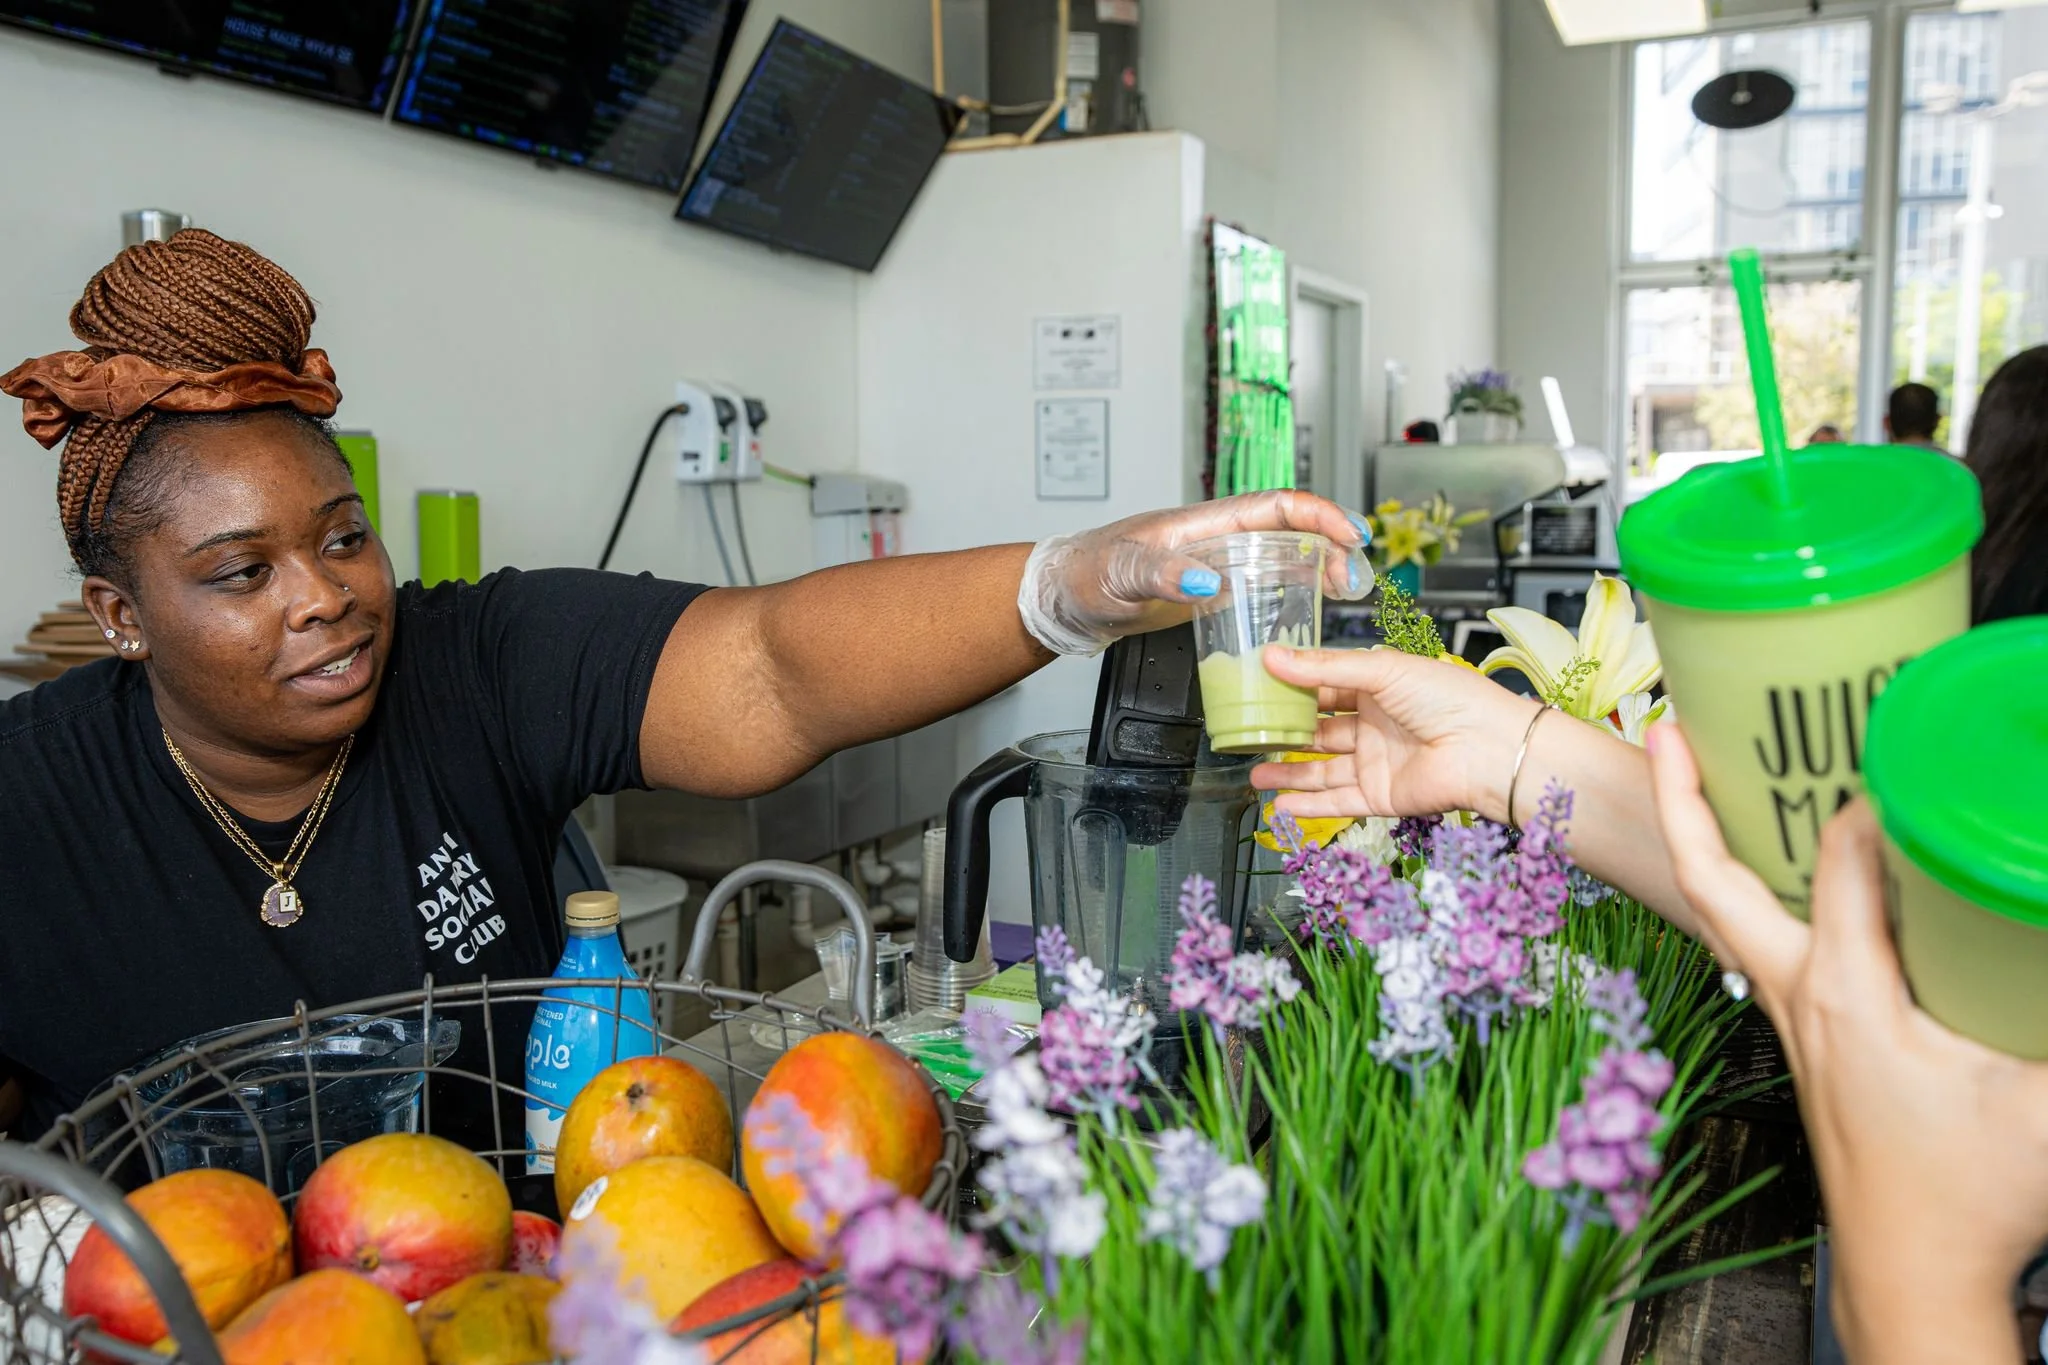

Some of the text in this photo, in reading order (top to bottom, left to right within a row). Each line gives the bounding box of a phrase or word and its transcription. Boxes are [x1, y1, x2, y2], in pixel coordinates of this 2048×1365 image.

[1754, 657, 1905, 778] JUI
[417, 832, 459, 888] ANI
[454, 914, 506, 965] CLUB
